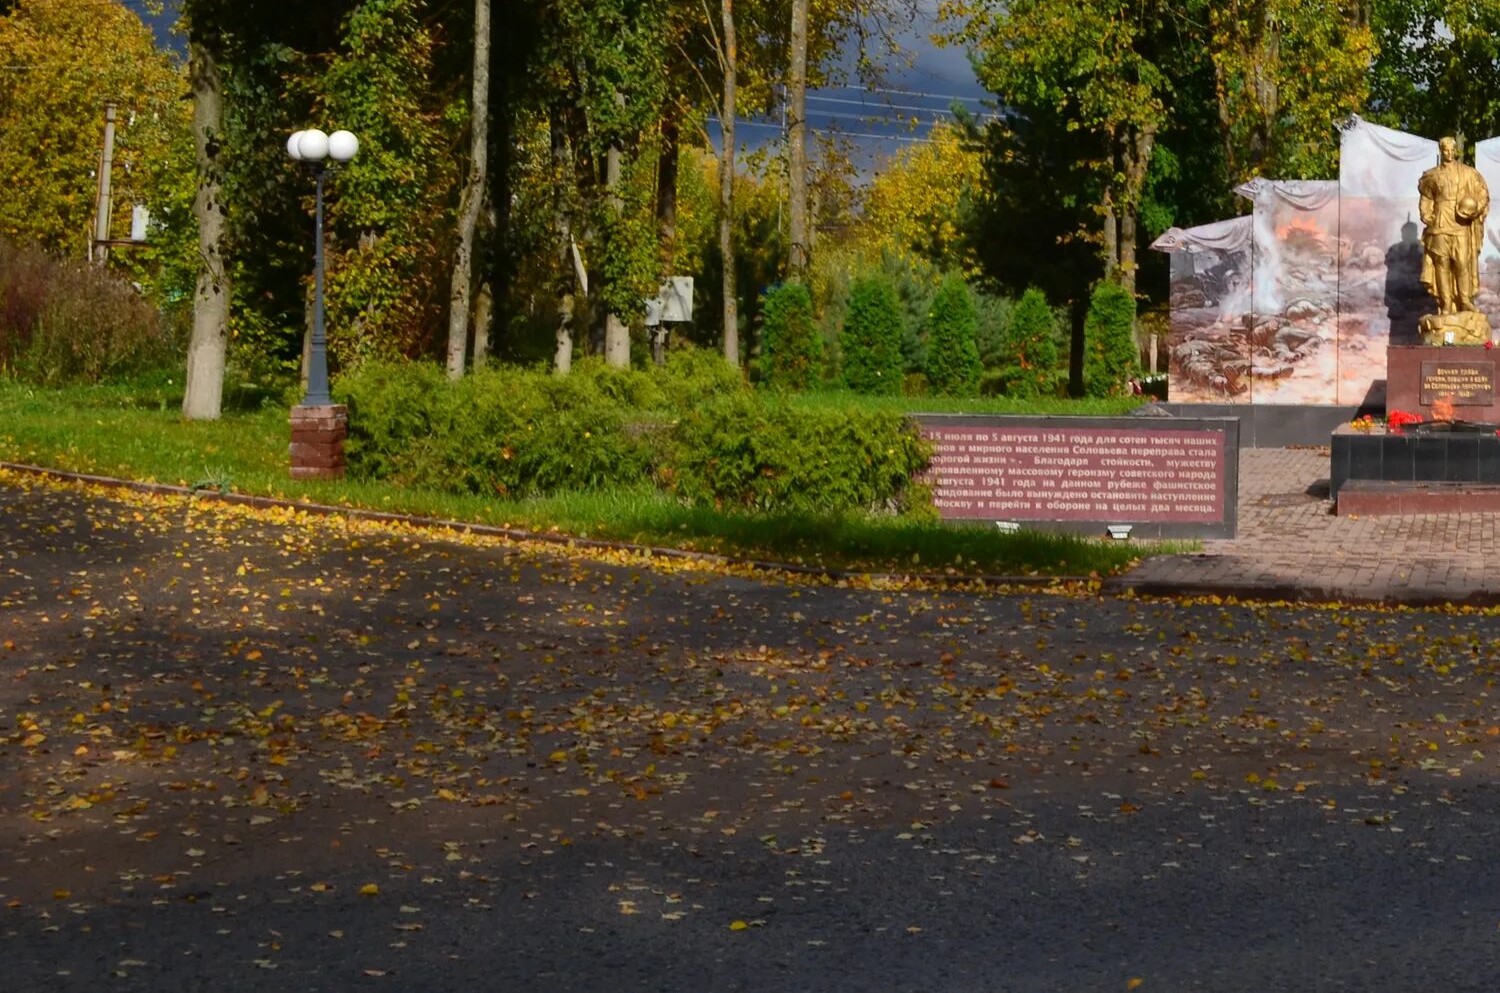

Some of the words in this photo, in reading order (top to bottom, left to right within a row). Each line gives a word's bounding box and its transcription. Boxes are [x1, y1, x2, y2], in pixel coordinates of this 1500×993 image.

[944, 433, 973, 441] июля
[976, 434, 989, 442] по
[992, 432, 998, 442] 5
[1001, 434, 1039, 444] августа
[1042, 433, 1066, 443] 1941
[1070, 435, 1093, 445] года
[1095, 436, 1116, 445] для
[1119, 437, 1147, 445] сотен
[1151, 437, 1180, 446] тысяч
[1183, 437, 1217, 446] наших
[958, 445, 966, 453] и
[968, 445, 1012, 455] мирного
[1015, 445, 1069, 454] населения
[1073, 445, 1128, 456] Соловьева
[1131, 447, 1185, 458] переправа
[1188, 448, 1217, 456] стала
[1034, 455, 1088, 467] Благодаря
[1101, 457, 1154, 467] стойкости,
[1166, 459, 1217, 469] мужеству
[1008, 468, 1064, 477] массовому
[1068, 469, 1116, 478] героизму
[1120, 470, 1175, 479] советского
[1179, 470, 1217, 480] народа
[937, 478, 974, 487] августа
[982, 477, 1005, 486] 1941
[1013, 479, 1036, 488] года
[1043, 479, 1056, 487] на
[1061, 480, 1101, 489] данном
[1107, 479, 1147, 490] рубеже
[1153, 480, 1217, 491] фашистское
[996, 487, 1023, 497] было
[1026, 489, 1088, 500] вынуждено
[1091, 491, 1148, 500] остановить
[1151, 492, 1217, 503] наступление
[935, 498, 973, 509] Москву
[989, 500, 1030, 510] перейти
[1035, 502, 1042, 510] к
[1046, 501, 1091, 511] обороне
[1096, 503, 1108, 511] на
[1113, 503, 1146, 512] целых
[1151, 504, 1170, 513] два
[1175, 505, 1216, 513] месяца.
